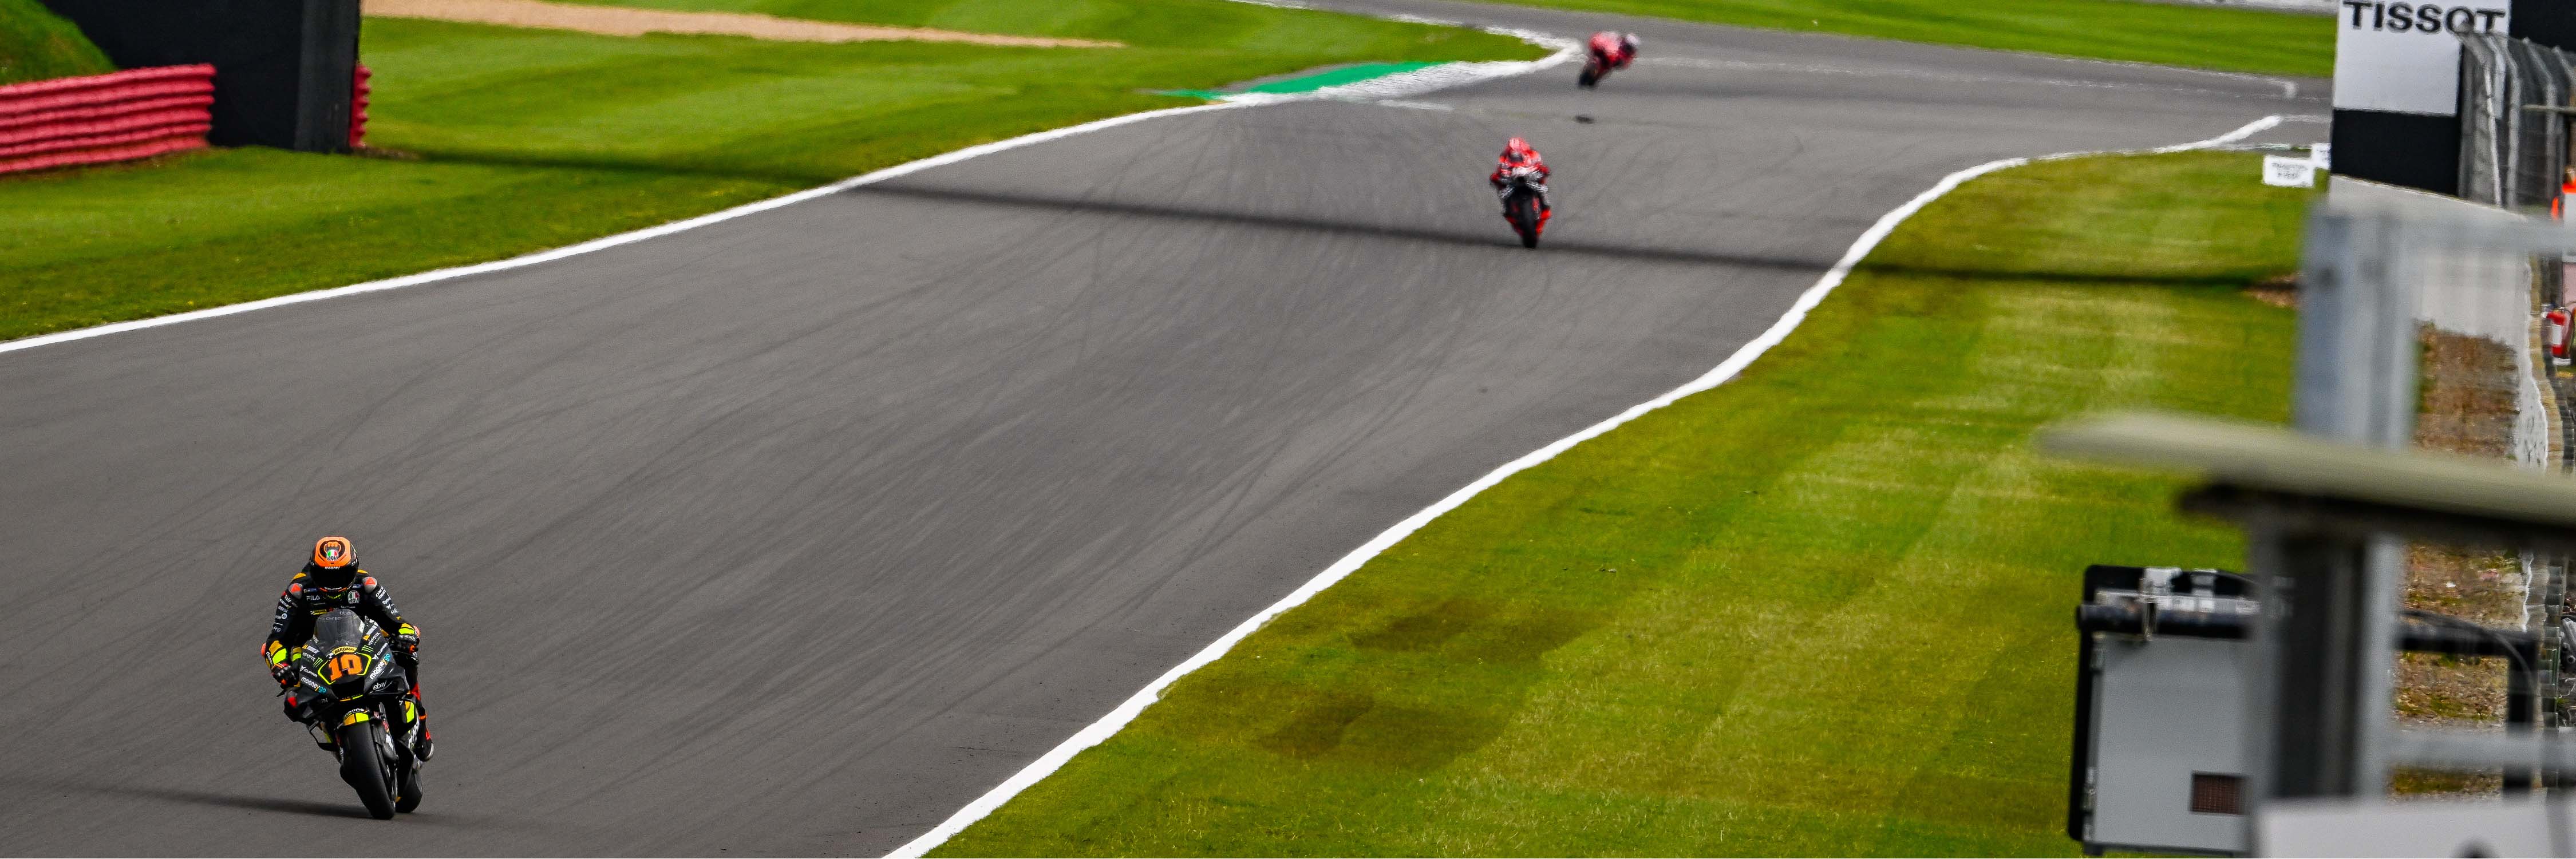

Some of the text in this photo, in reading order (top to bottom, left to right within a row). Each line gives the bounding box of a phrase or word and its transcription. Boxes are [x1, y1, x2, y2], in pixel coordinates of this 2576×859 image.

[2342, 1, 2506, 34] TISSOT
[329, 654, 362, 681] 10
[373, 680, 387, 690] ebay
